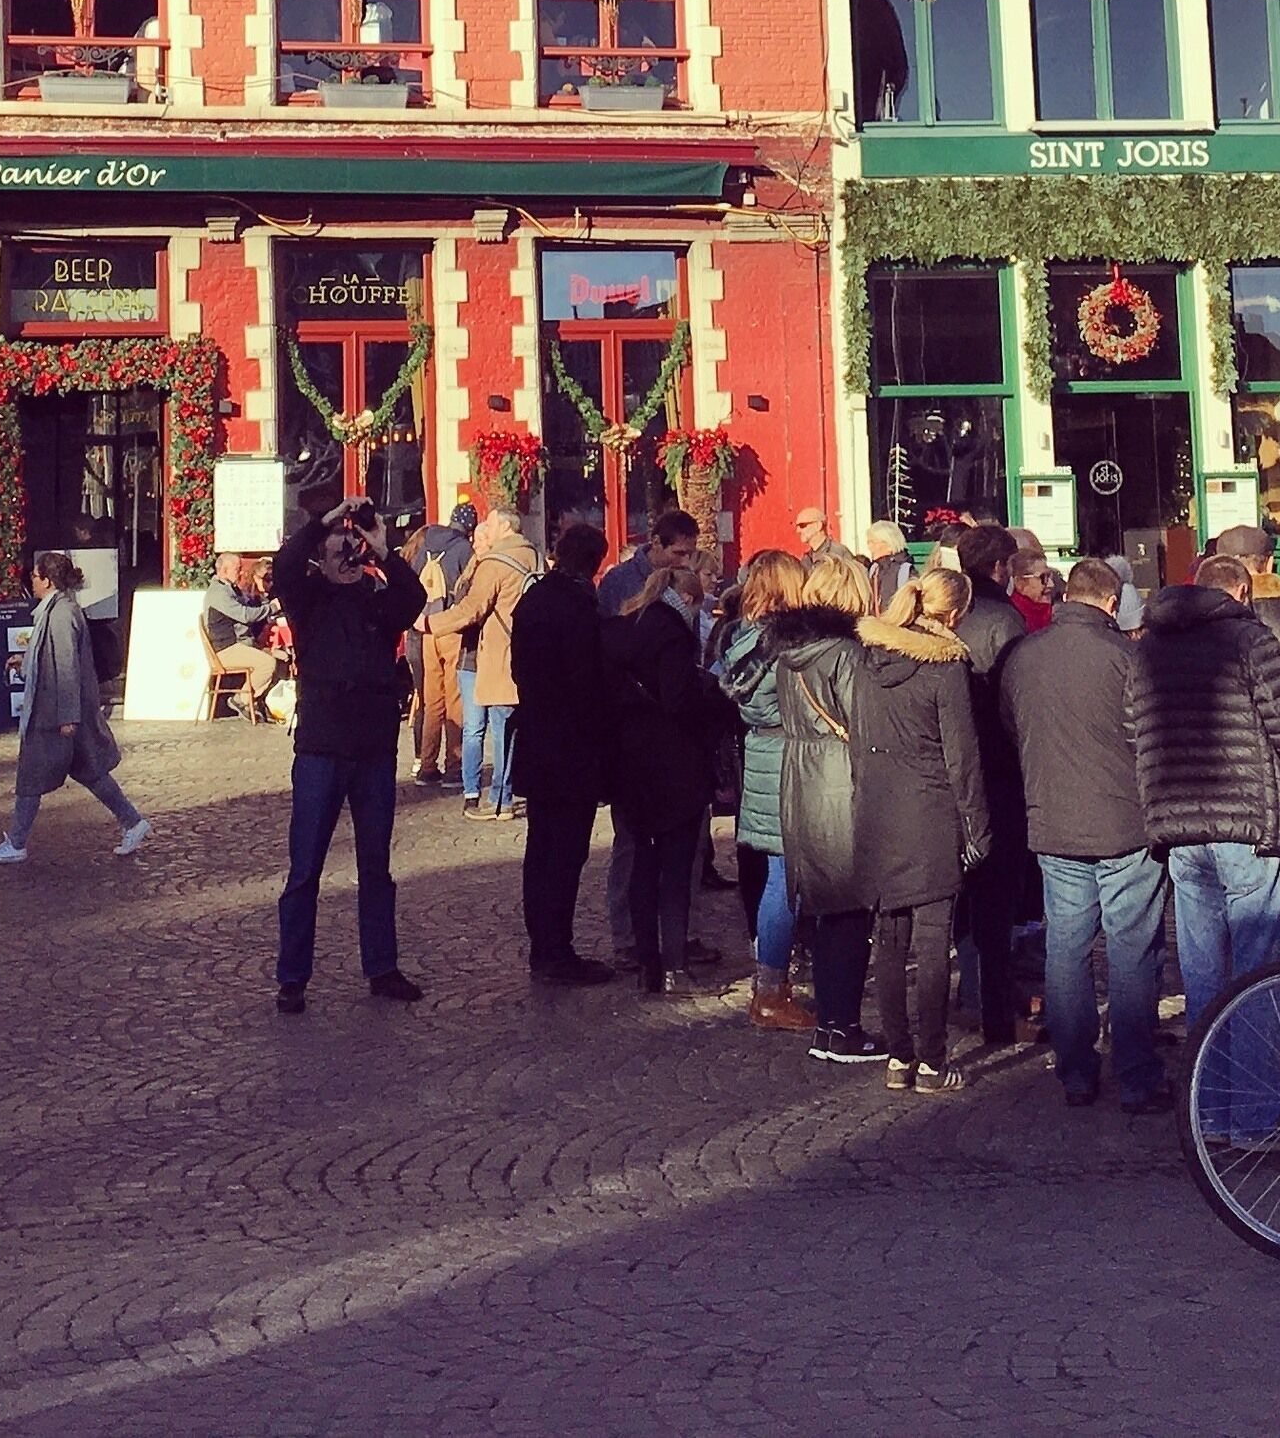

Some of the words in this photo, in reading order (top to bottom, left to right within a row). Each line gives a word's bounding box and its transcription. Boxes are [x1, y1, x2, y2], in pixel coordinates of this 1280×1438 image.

[1029, 141, 1105, 168] SINT
[1117, 140, 1210, 167] JORIS
[96, 160, 167, 186] d'Or
[54, 258, 113, 282] BEER
[343, 273, 360, 284] LA
